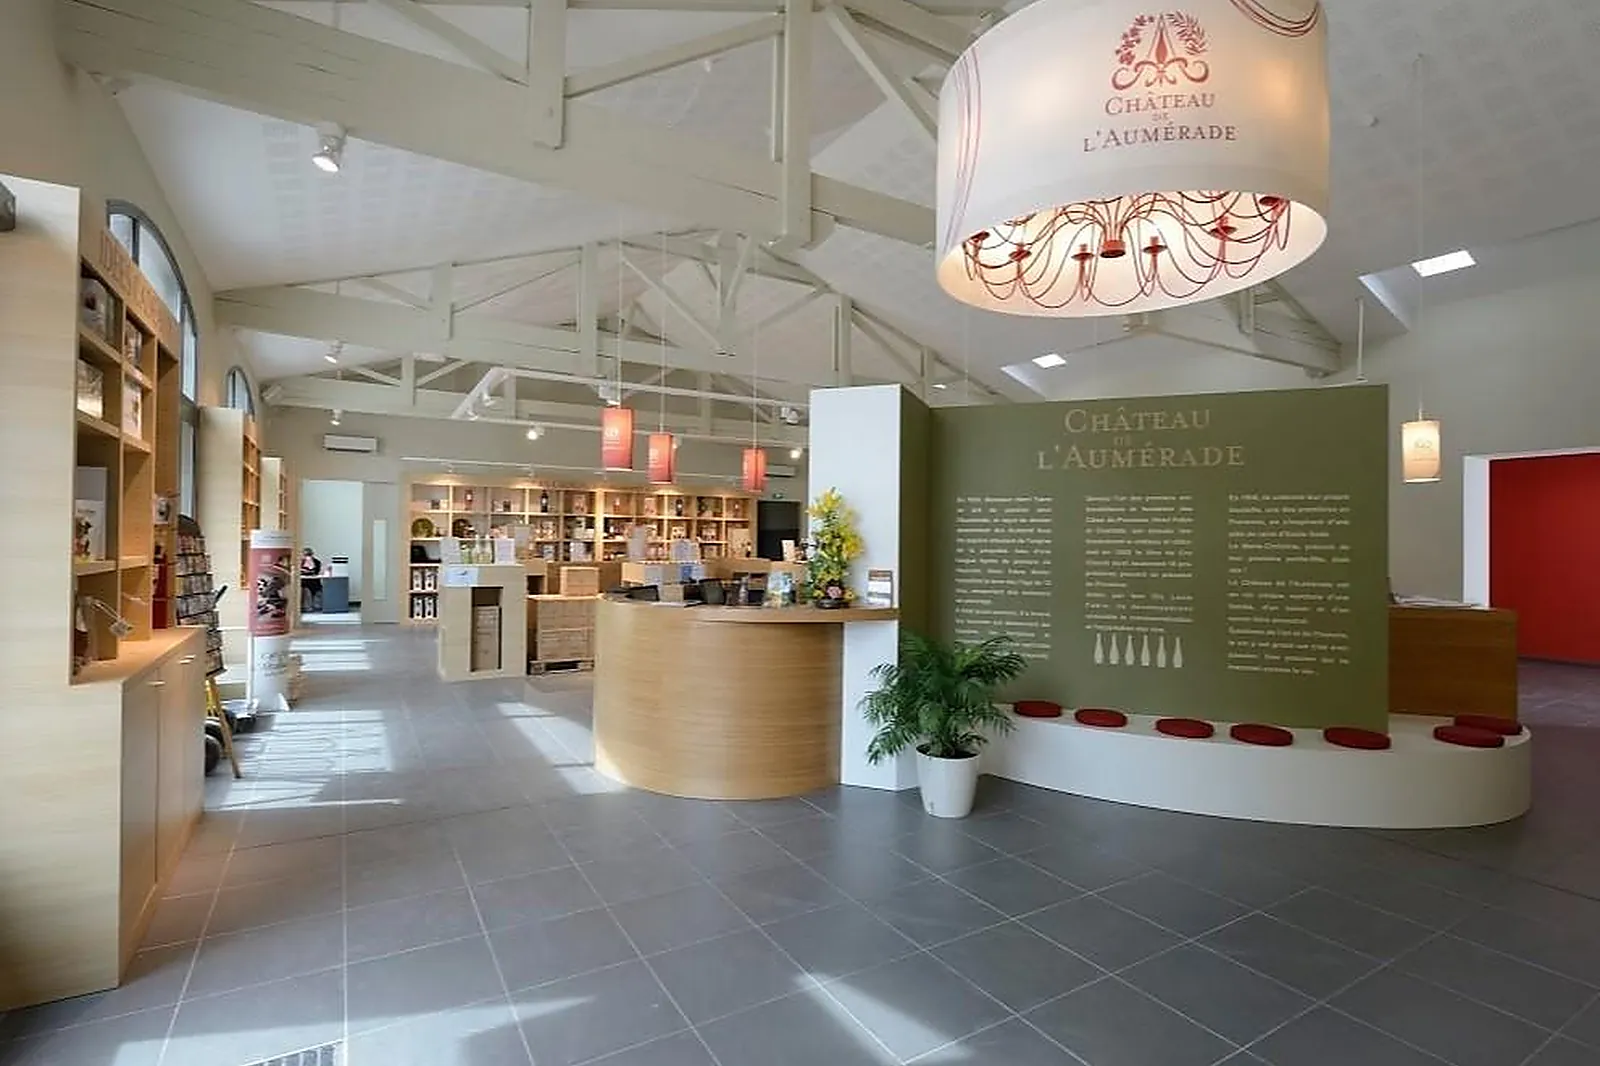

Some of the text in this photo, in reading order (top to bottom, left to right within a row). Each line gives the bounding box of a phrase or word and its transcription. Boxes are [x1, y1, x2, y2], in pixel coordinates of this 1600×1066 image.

[1105, 92, 1216, 116] CHÂTEAU
[1064, 406, 1211, 433] CHÂTEAU
[1038, 441, 1245, 469] L'AUMÉRADE
